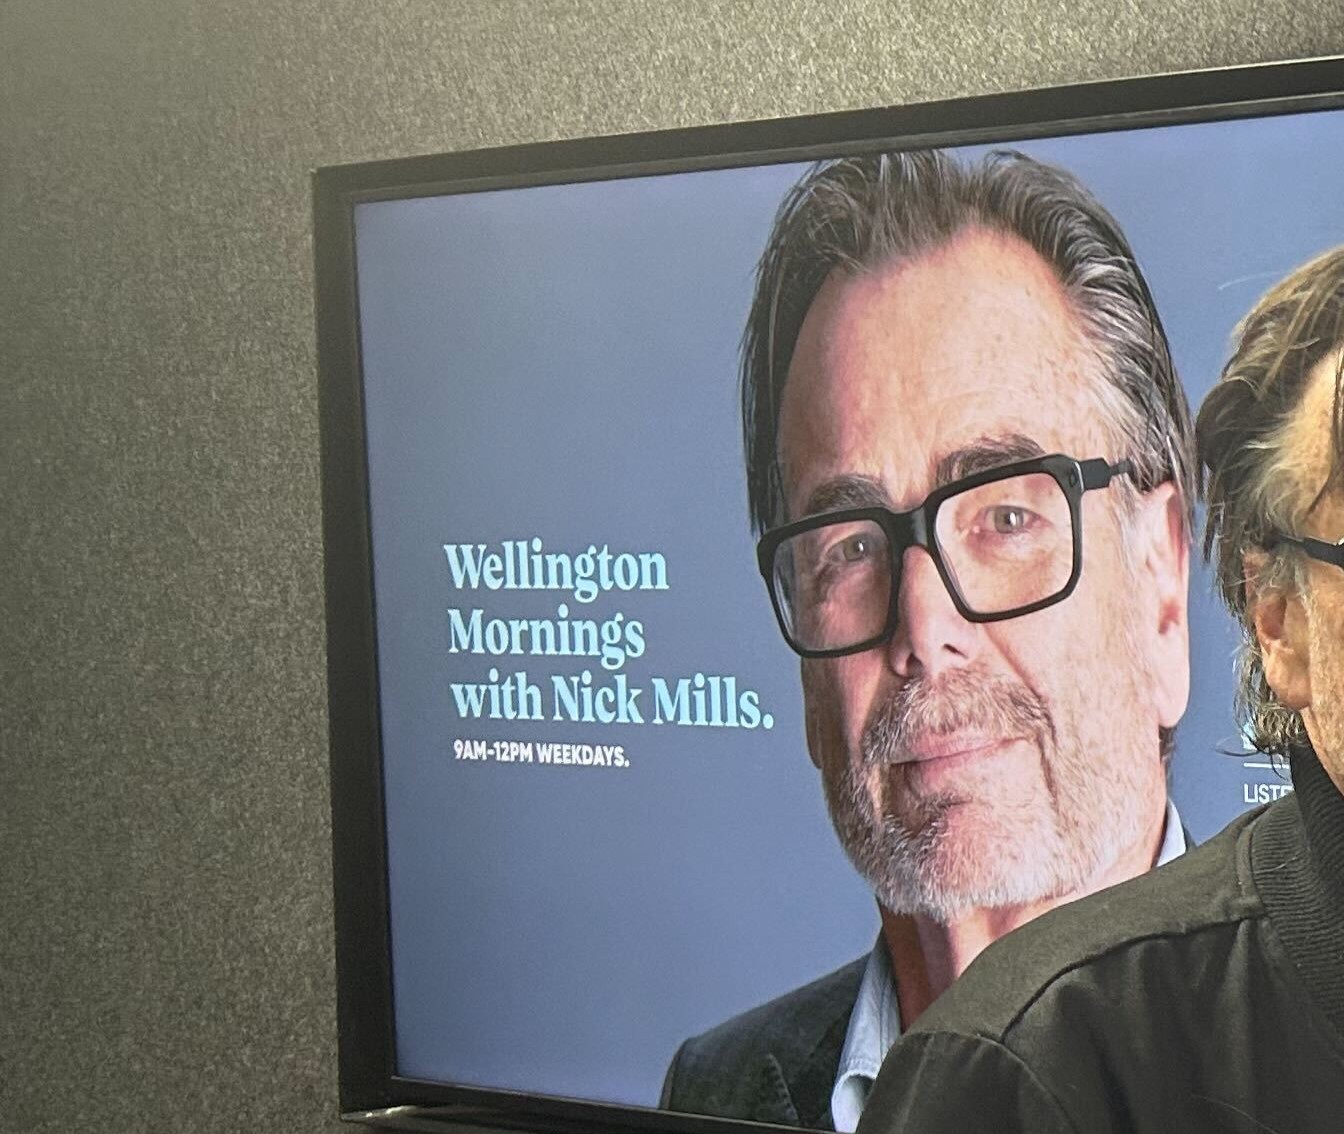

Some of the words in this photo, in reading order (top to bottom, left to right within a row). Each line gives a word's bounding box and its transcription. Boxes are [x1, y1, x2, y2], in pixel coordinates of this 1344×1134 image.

[444, 538, 669, 603] Wellington
[448, 604, 645, 669] Mornings
[450, 668, 544, 720] with
[552, 670, 644, 723] Nick
[652, 673, 773, 729] Mills.
[454, 740, 533, 762] 9AM-12PM
[536, 743, 629, 767] WEEKDAYS.
[1243, 783, 1294, 803] LIST
